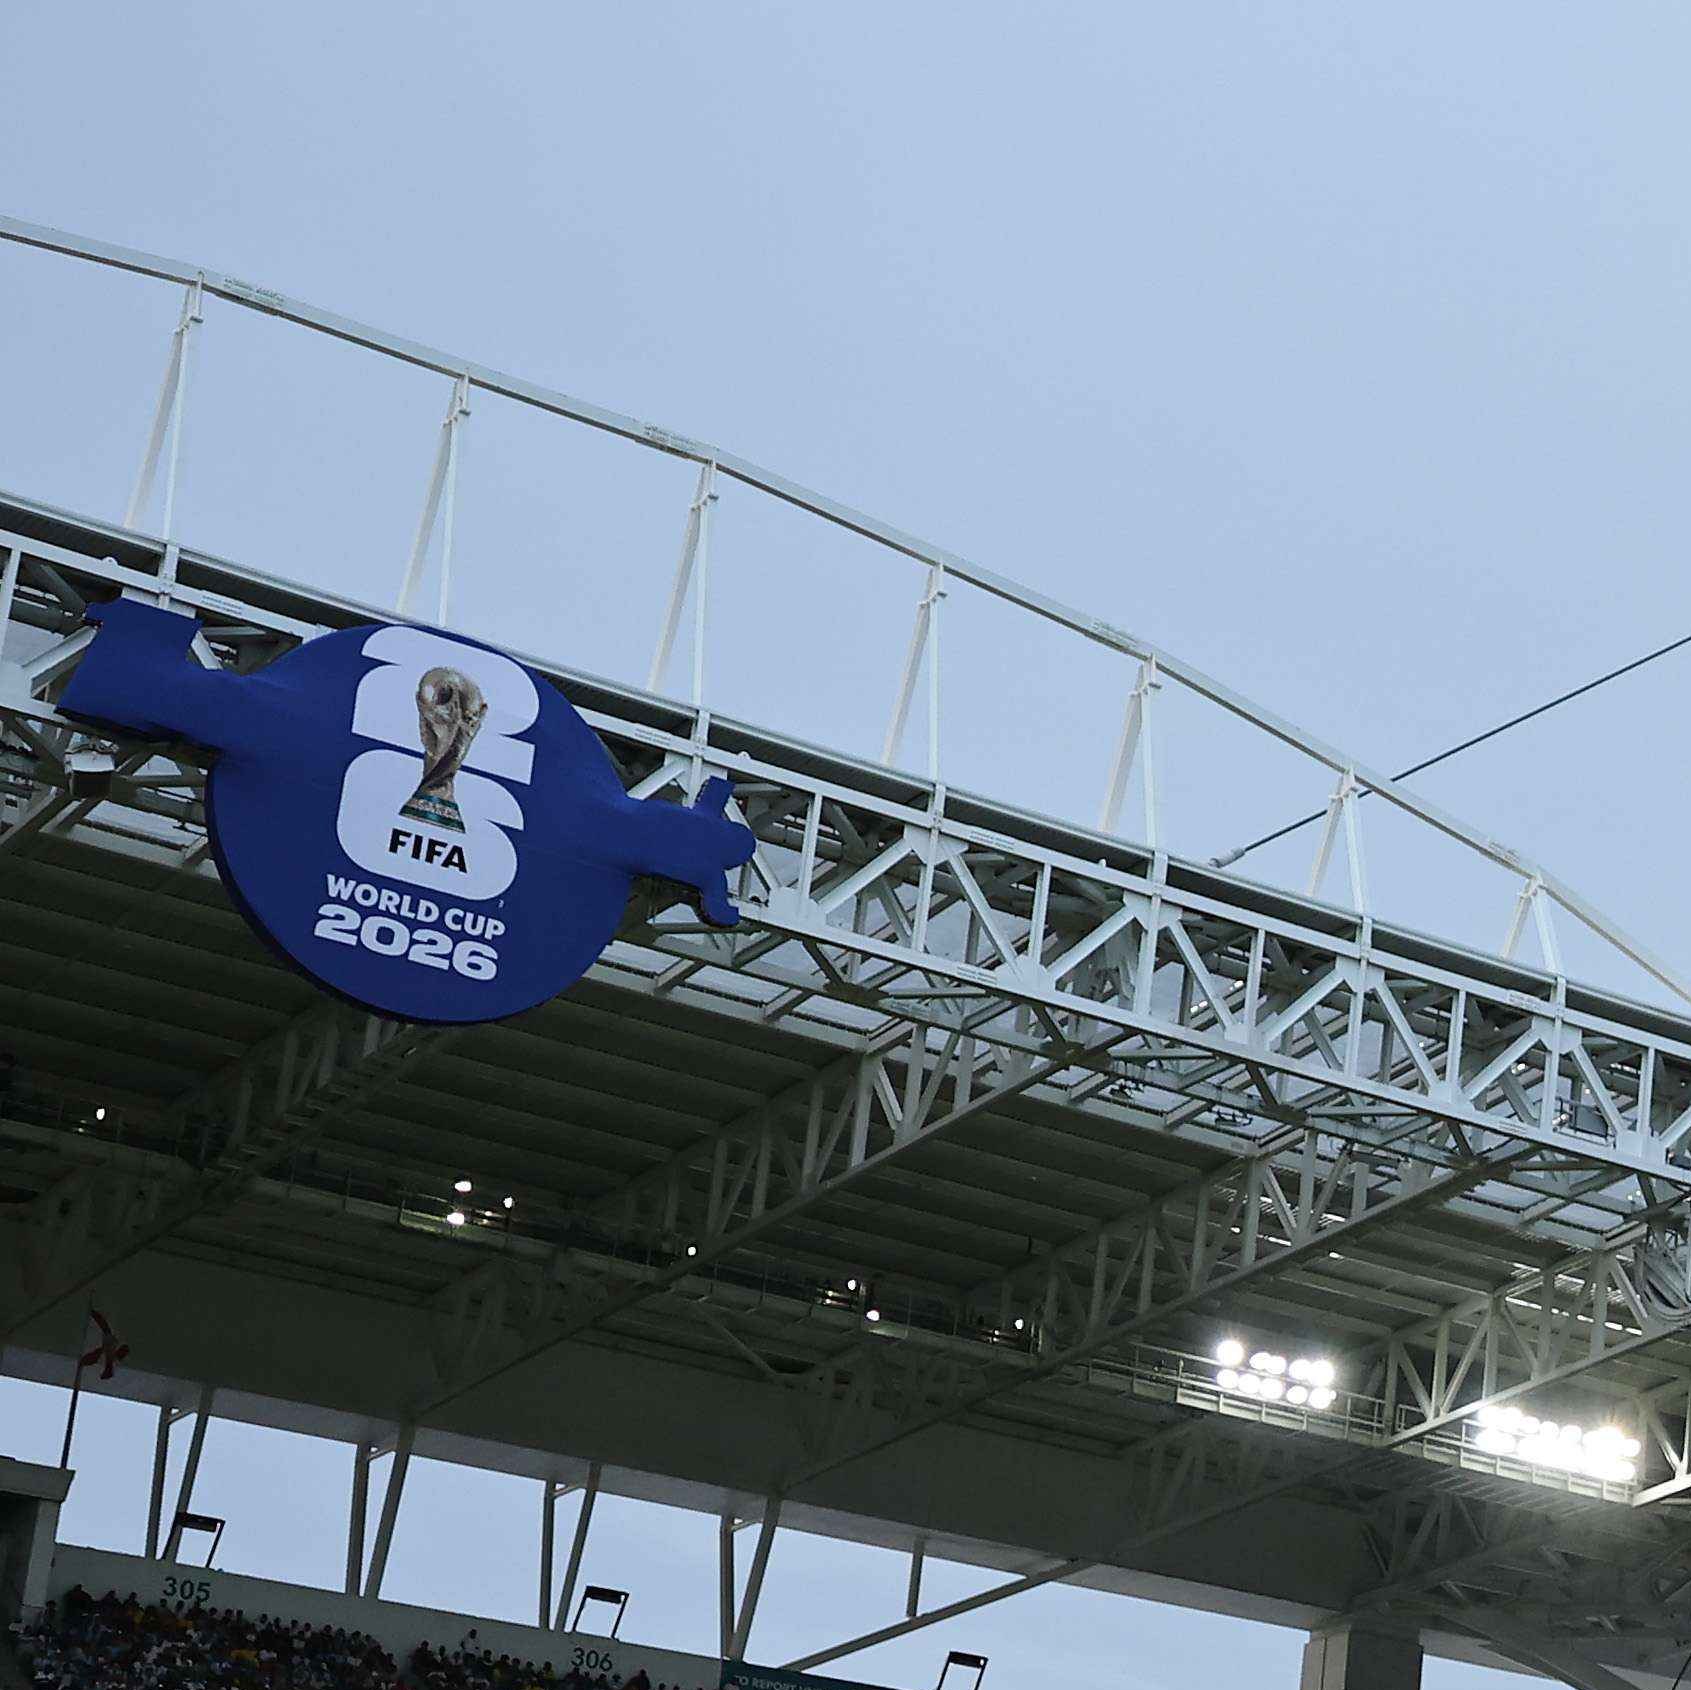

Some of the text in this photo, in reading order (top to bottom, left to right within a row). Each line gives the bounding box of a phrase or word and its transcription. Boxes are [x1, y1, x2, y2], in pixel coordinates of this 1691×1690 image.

[388, 827, 468, 874] FIFA
[326, 873, 506, 941] WORLD CUP
[314, 903, 499, 981] 2026
[162, 1575, 211, 1603] 305
[571, 1646, 614, 1673] 306
